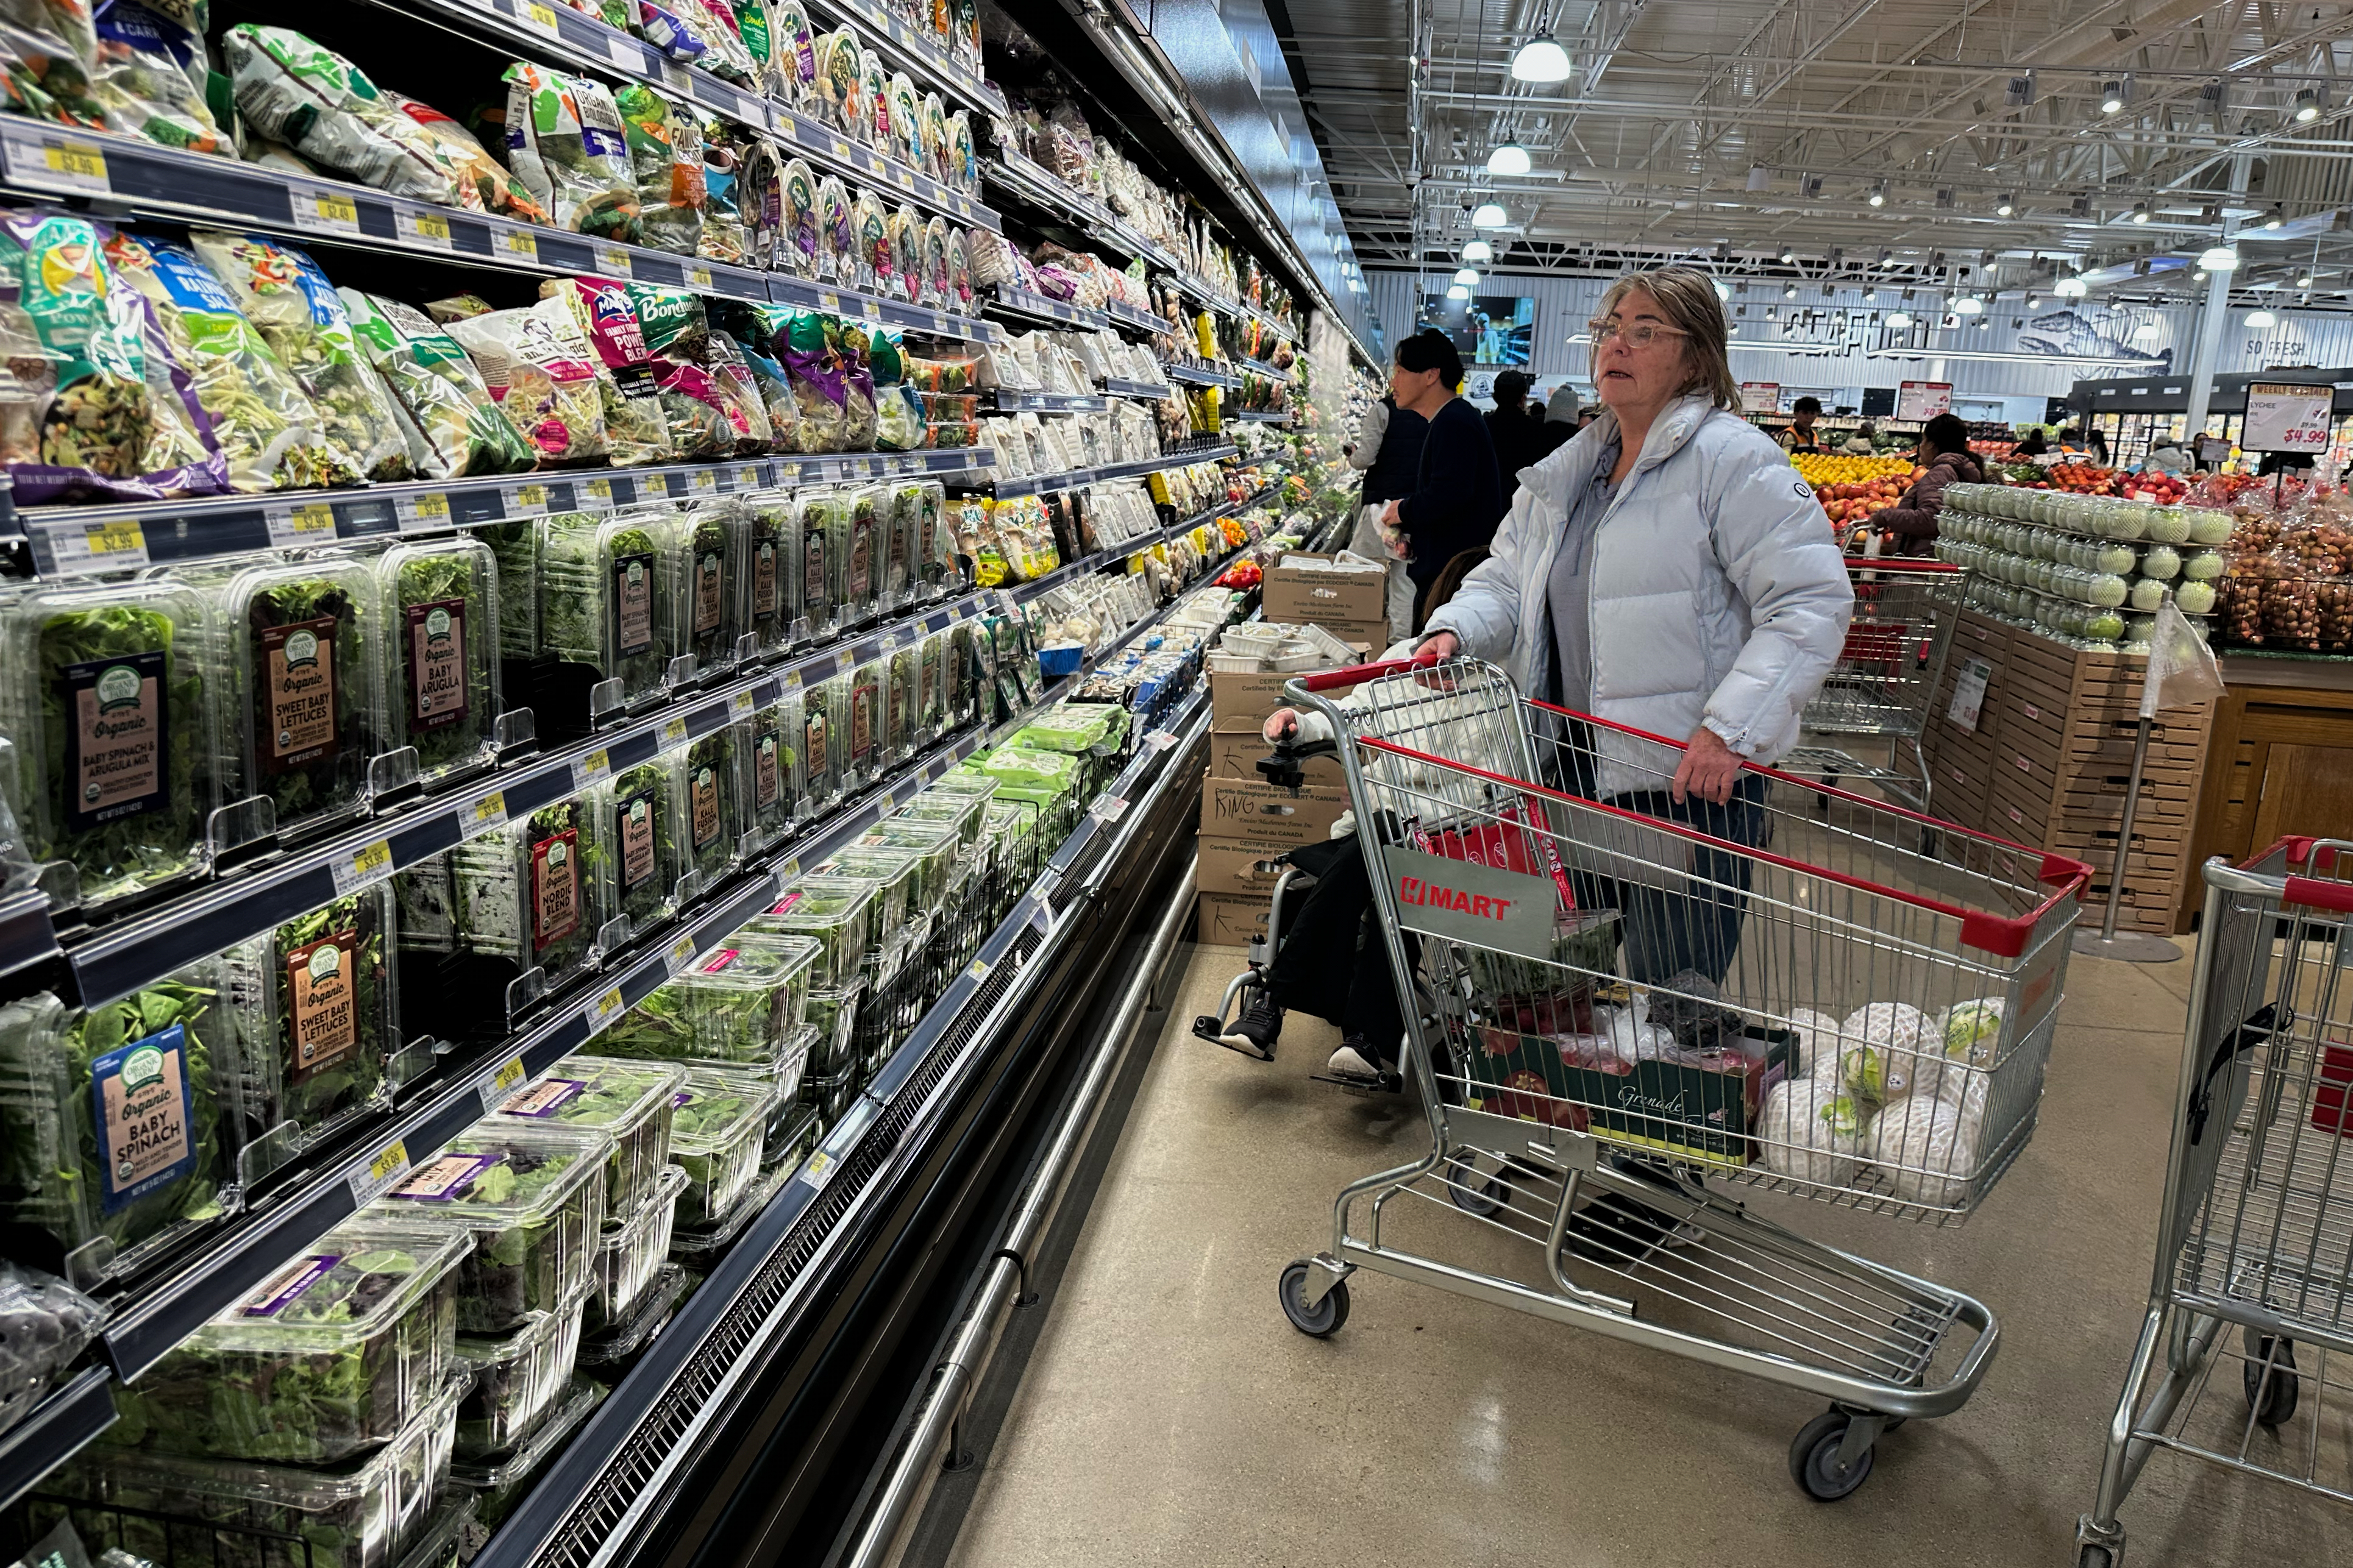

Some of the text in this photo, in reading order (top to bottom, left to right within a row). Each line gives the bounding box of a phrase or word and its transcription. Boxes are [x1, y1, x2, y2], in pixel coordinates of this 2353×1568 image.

[62, 154, 94, 176] $2.99
[328, 205, 349, 221] $2.49
[426, 222, 443, 238] $2.49
[516, 237, 532, 253] $2.99
[638, 296, 705, 322] Bonduelle
[604, 325, 627, 338] FAMILY
[1787, 310, 1931, 361] SEAFOOD
[614, 333, 646, 351] POWE
[2247, 340, 2263, 354] SO
[2257, 385, 2329, 396] WEEKLY SPECIALS
[2284, 428, 2326, 444] $4.99
[304, 512, 326, 529] $2.99
[103, 532, 135, 550] $2.99
[758, 588, 774, 598] FUSION
[760, 580, 772, 590] KALE
[699, 601, 717, 616] FUSION
[289, 640, 315, 653] ORGANIC
[294, 650, 311, 658] FARM
[425, 645, 455, 664] Organic
[429, 664, 452, 679] BABY
[102, 679, 137, 692] ORGANIC
[284, 673, 324, 694] Organic
[421, 675, 460, 695] ARUGULA
[109, 689, 131, 699] FARM
[276, 692, 329, 717] SWEET BABY
[281, 706, 327, 729] LETTUCES
[94, 715, 147, 740] Organic
[84, 741, 155, 767] BABY SPINACH &
[89, 753, 151, 778] ARUGULA MIX
[1237, 790, 1267, 798] Biologique
[484, 802, 500, 817] $3.99
[701, 804, 714, 819] KALE
[1215, 790, 1255, 820] KING
[697, 811, 717, 830] FUSION
[629, 826, 649, 843] Organic
[364, 850, 384, 870] $3.99
[546, 870, 570, 889] Organic
[543, 884, 572, 907] NORDIC
[1400, 876, 1511, 921] H MART
[546, 898, 570, 916] BLEND
[313, 953, 338, 970] ORGANIC
[318, 963, 334, 973] FARM
[308, 982, 344, 1007] Organic
[605, 995, 619, 1011] $3.99
[301, 999, 351, 1031] SWEET BABY
[305, 1013, 347, 1041] LETTUCES
[127, 1055, 160, 1076] ORGANIC
[133, 1065, 155, 1081] FARM
[504, 1066, 519, 1085] $3.99
[123, 1088, 173, 1120] Organic
[1617, 1085, 1689, 1113] Grenade
[130, 1110, 168, 1141] BABY
[117, 1120, 180, 1163] SPINACH
[135, 1139, 182, 1166] MILD AND TENDER
[150, 1152, 169, 1166] LEAVES
[380, 1152, 400, 1174] $3.99
[422, 1166, 447, 1181] MIX
